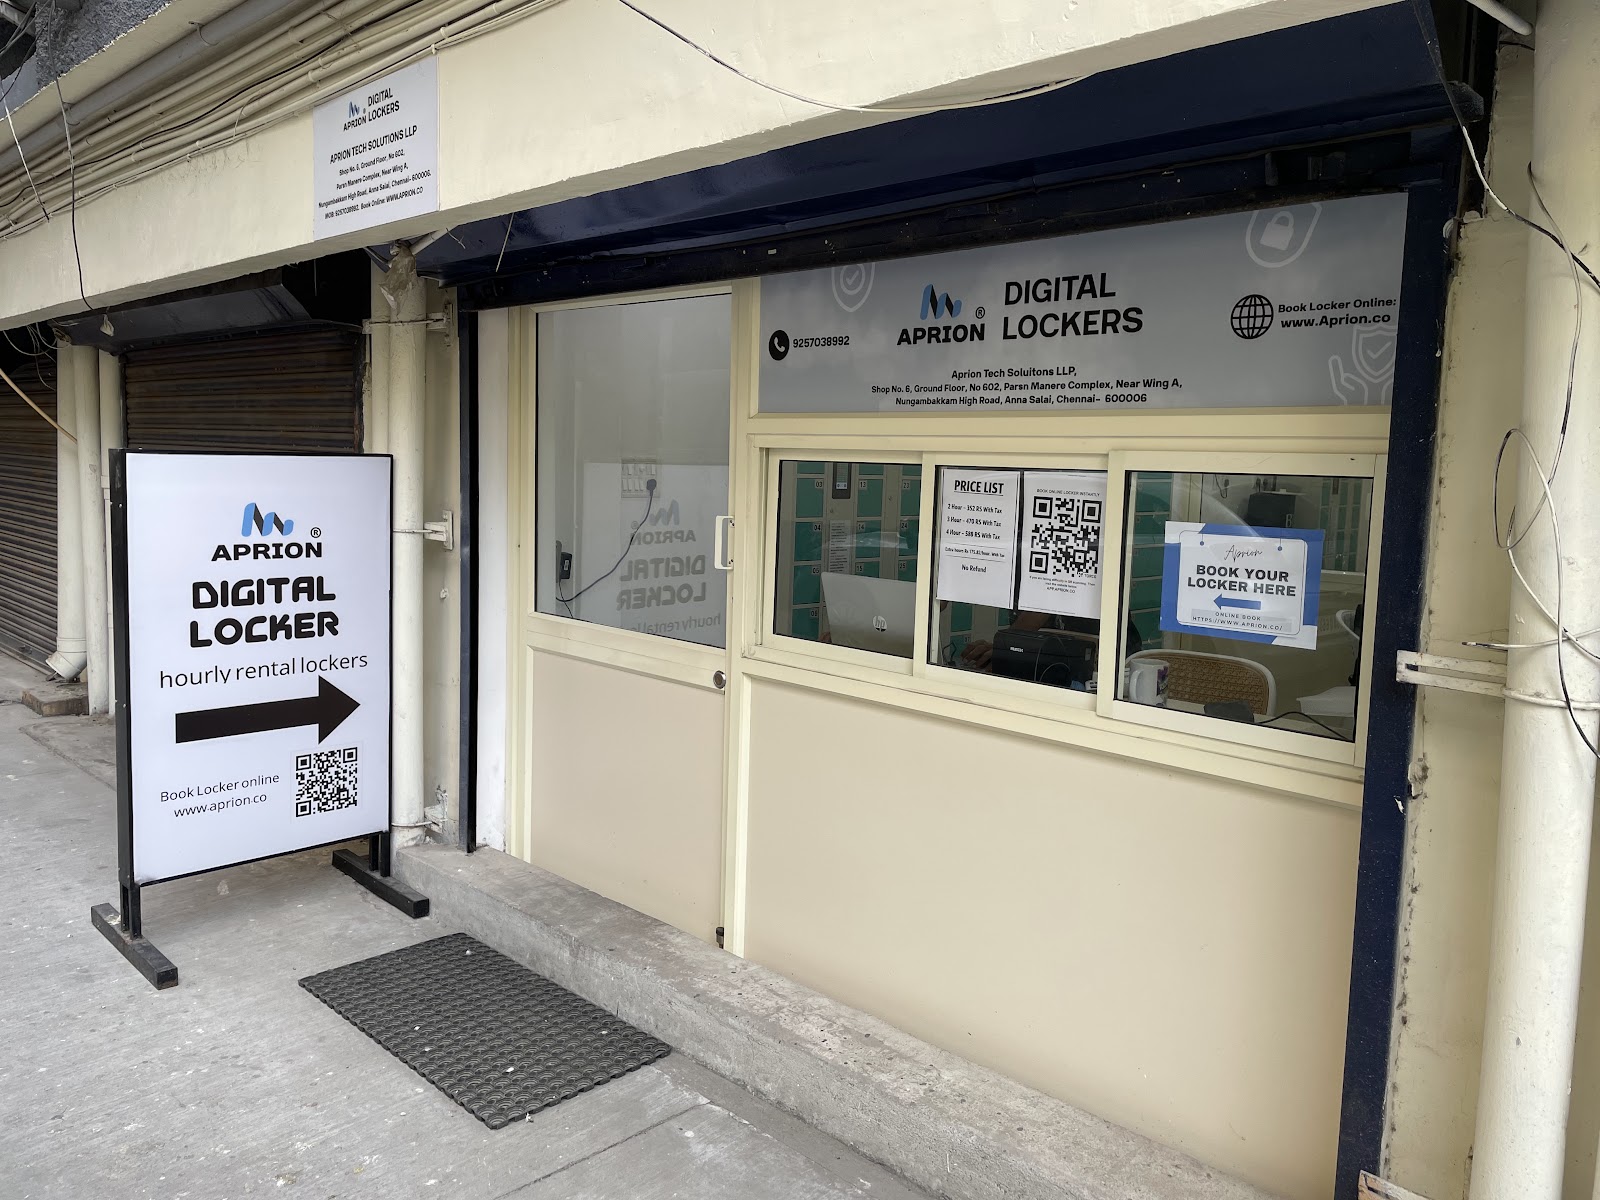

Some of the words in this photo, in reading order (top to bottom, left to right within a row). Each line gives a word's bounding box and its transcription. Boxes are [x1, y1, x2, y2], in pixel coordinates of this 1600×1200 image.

[368, 88, 393, 107] DIGITAL
[343, 115, 366, 132] APRION
[368, 100, 400, 122] LOCKERS
[330, 147, 351, 164] APRION
[352, 142, 366, 157] TECH
[368, 130, 404, 151] SOLUTIONS
[405, 125, 417, 138] LLP
[360, 159, 375, 169] Ground
[362, 172, 381, 182] Complex,
[382, 168, 391, 176] Near
[392, 164, 403, 174] Wing
[348, 193, 357, 201] High
[1005, 272, 1116, 305] DIGITAL
[1278, 303, 1306, 313] Book
[1309, 300, 1351, 311] Locker
[1353, 297, 1397, 309] Online:
[897, 323, 985, 346] APRION
[1002, 307, 1144, 340] LOCKERS
[1281, 312, 1390, 328] www.Aprion.co
[793, 335, 850, 348] 9257038992
[951, 369, 981, 380] Aprion
[983, 368, 1005, 378] Tech
[1007, 367, 1054, 377] Soluitons
[1056, 366, 1077, 377] LLP,
[871, 385, 890, 395] Shop
[891, 384, 904, 393] No.
[905, 384, 912, 394] 6,
[914, 383, 943, 393] Ground
[945, 382, 968, 393] Floor,
[969, 382, 981, 392] No
[982, 382, 1002, 392] 602,
[1003, 382, 1028, 391] Parsn
[1030, 381, 1066, 390] Manere
[1067, 379, 1113, 391] Complex,
[1116, 379, 1140, 389] Near
[1142, 378, 1169, 390] Wing
[1171, 378, 1183, 389] A,
[896, 396, 957, 406] Nungambakkam
[959, 396, 977, 406] High
[979, 395, 1003, 405] Road,
[1005, 395, 1027, 404] Anna
[1029, 394, 1054, 405] Salai,
[1105, 393, 1147, 403] 600006
[954, 480, 981, 492] PRICE
[984, 482, 1004, 494] LIST
[211, 542, 322, 562] APRION
[1224, 545, 1262, 562] Aprion
[1196, 564, 1239, 578] BOOK
[1244, 568, 1289, 582] YOUR
[193, 576, 336, 610] DIGITAL
[1188, 577, 1248, 593] LOCKER
[1253, 583, 1296, 597] HERE
[190, 611, 339, 649] LOCKER
[159, 665, 231, 689] hourly
[236, 657, 295, 680] rental
[300, 652, 368, 674] lockers
[160, 788, 194, 803] Book
[196, 780, 240, 796] Locker
[241, 772, 280, 790] online
[174, 791, 267, 818] www.aprion.co
